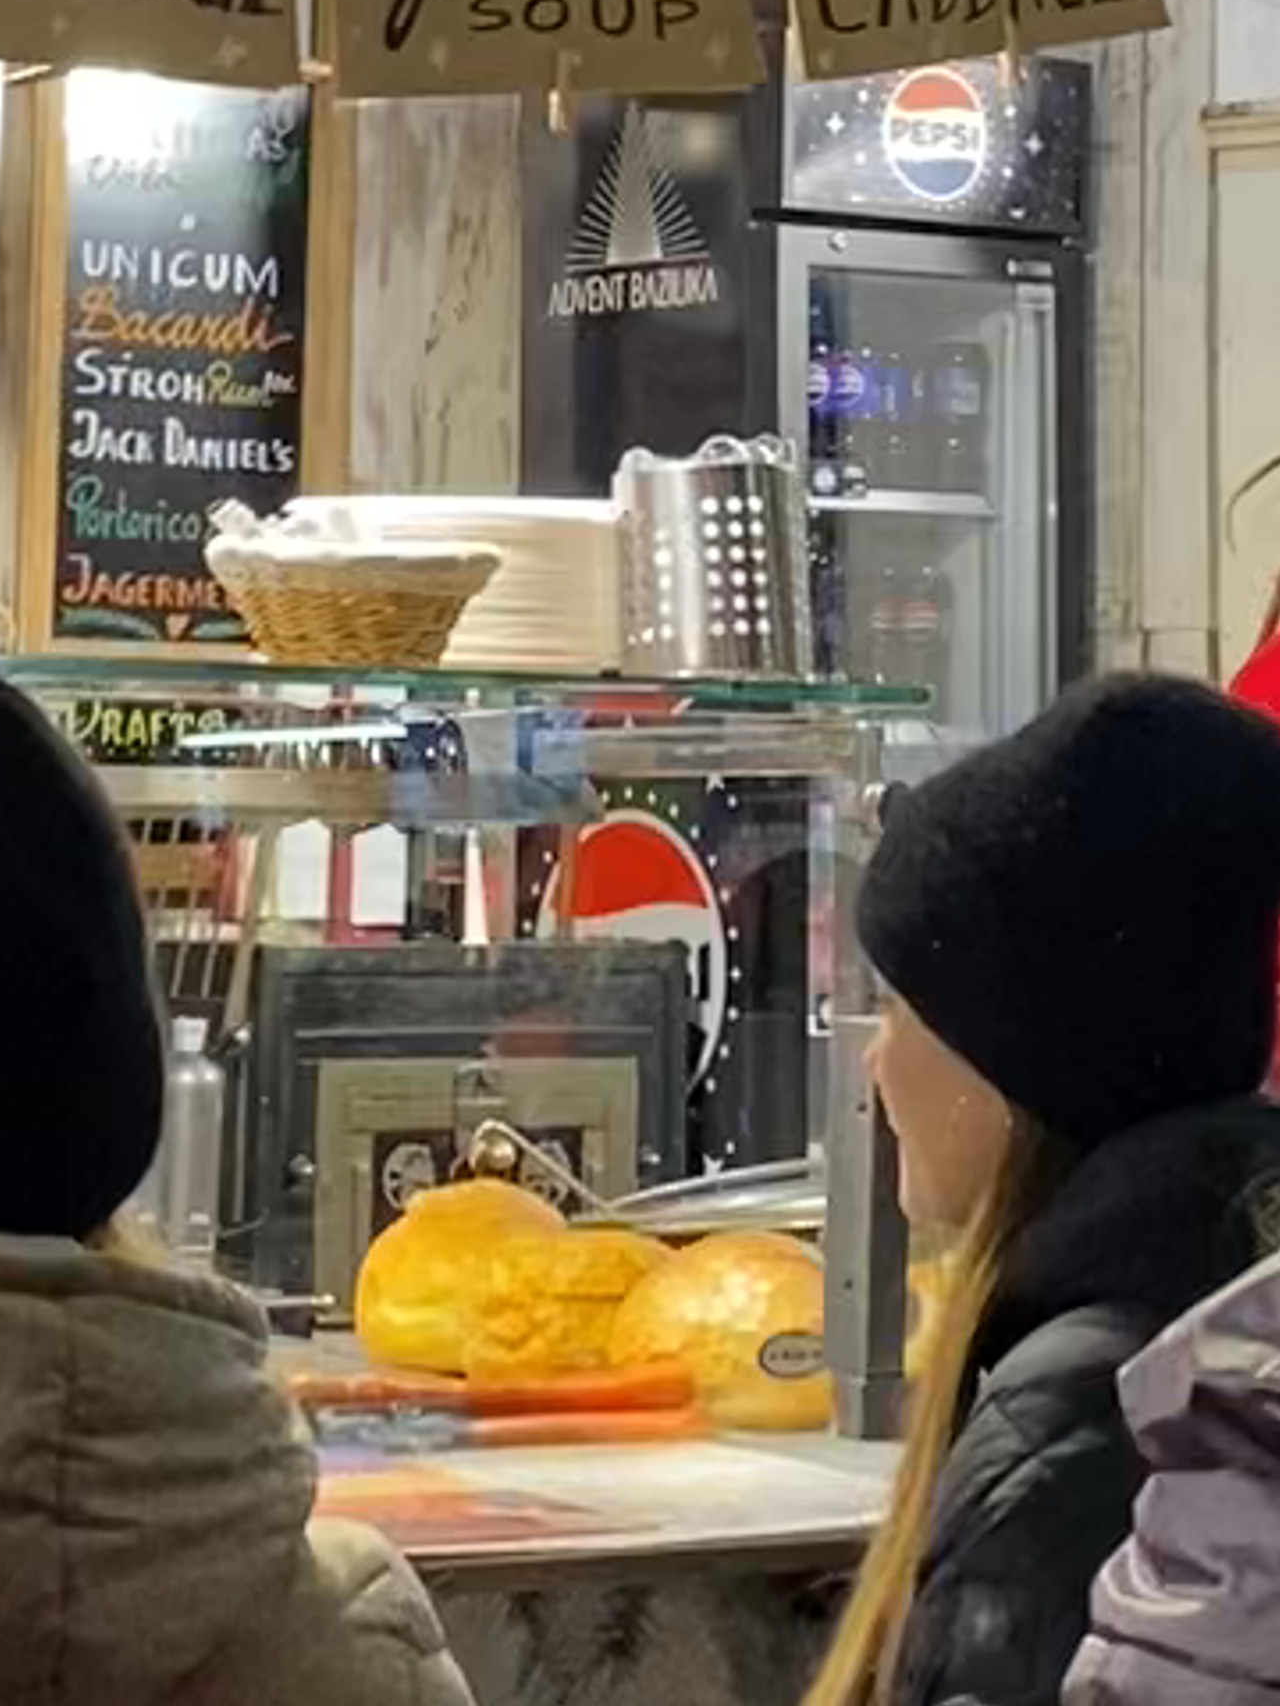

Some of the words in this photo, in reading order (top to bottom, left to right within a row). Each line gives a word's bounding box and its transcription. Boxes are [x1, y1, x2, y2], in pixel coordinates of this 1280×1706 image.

[888, 117, 984, 154] PEPSI
[80, 238, 279, 298] UNICUM
[70, 280, 295, 350] Bacardi
[548, 276, 628, 318] ADVENT
[74, 348, 204, 406] STROH
[68, 408, 156, 463] JACK
